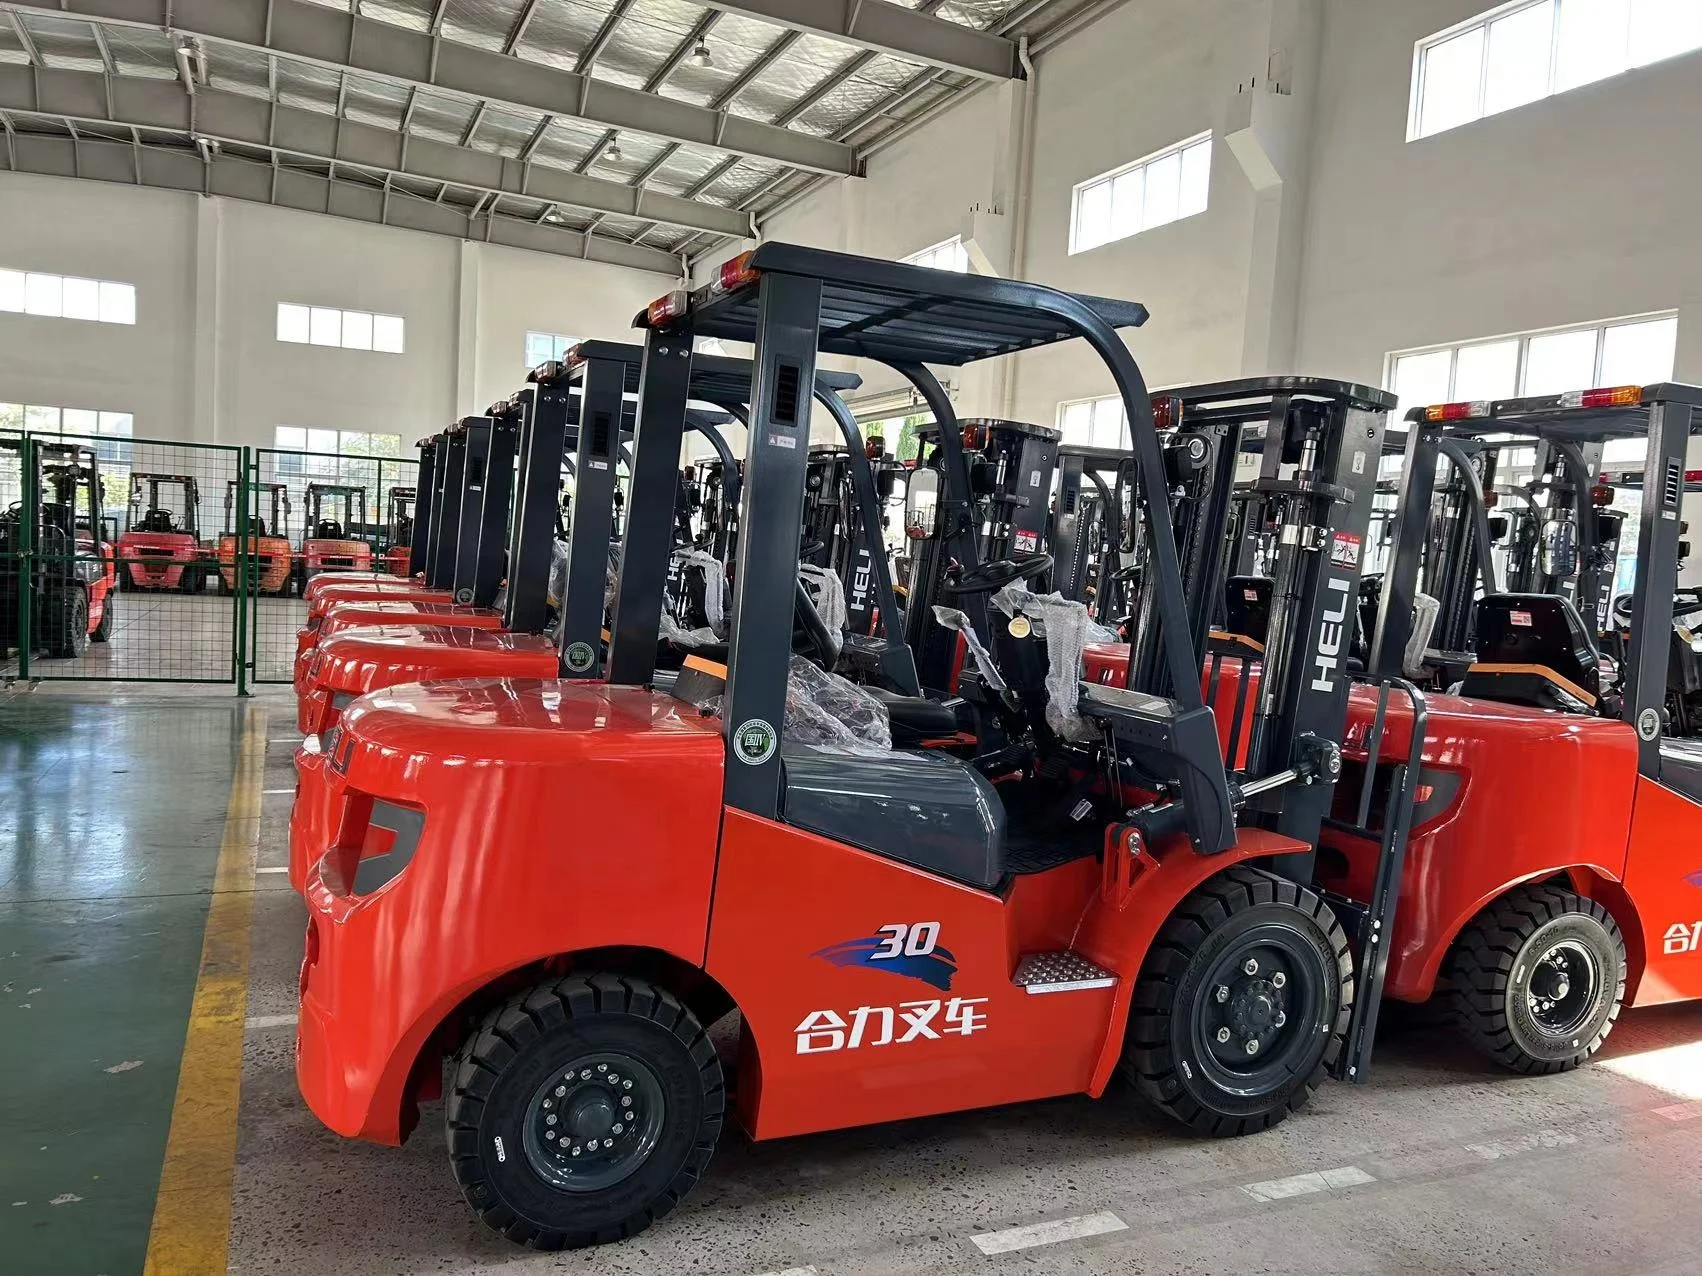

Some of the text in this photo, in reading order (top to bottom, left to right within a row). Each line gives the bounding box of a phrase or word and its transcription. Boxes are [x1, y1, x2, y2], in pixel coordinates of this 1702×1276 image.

[850, 548, 872, 611] HELI
[1312, 577, 1350, 693] HELI
[869, 921, 941, 960] 30
[793, 997, 989, 1055] 合力叉车
